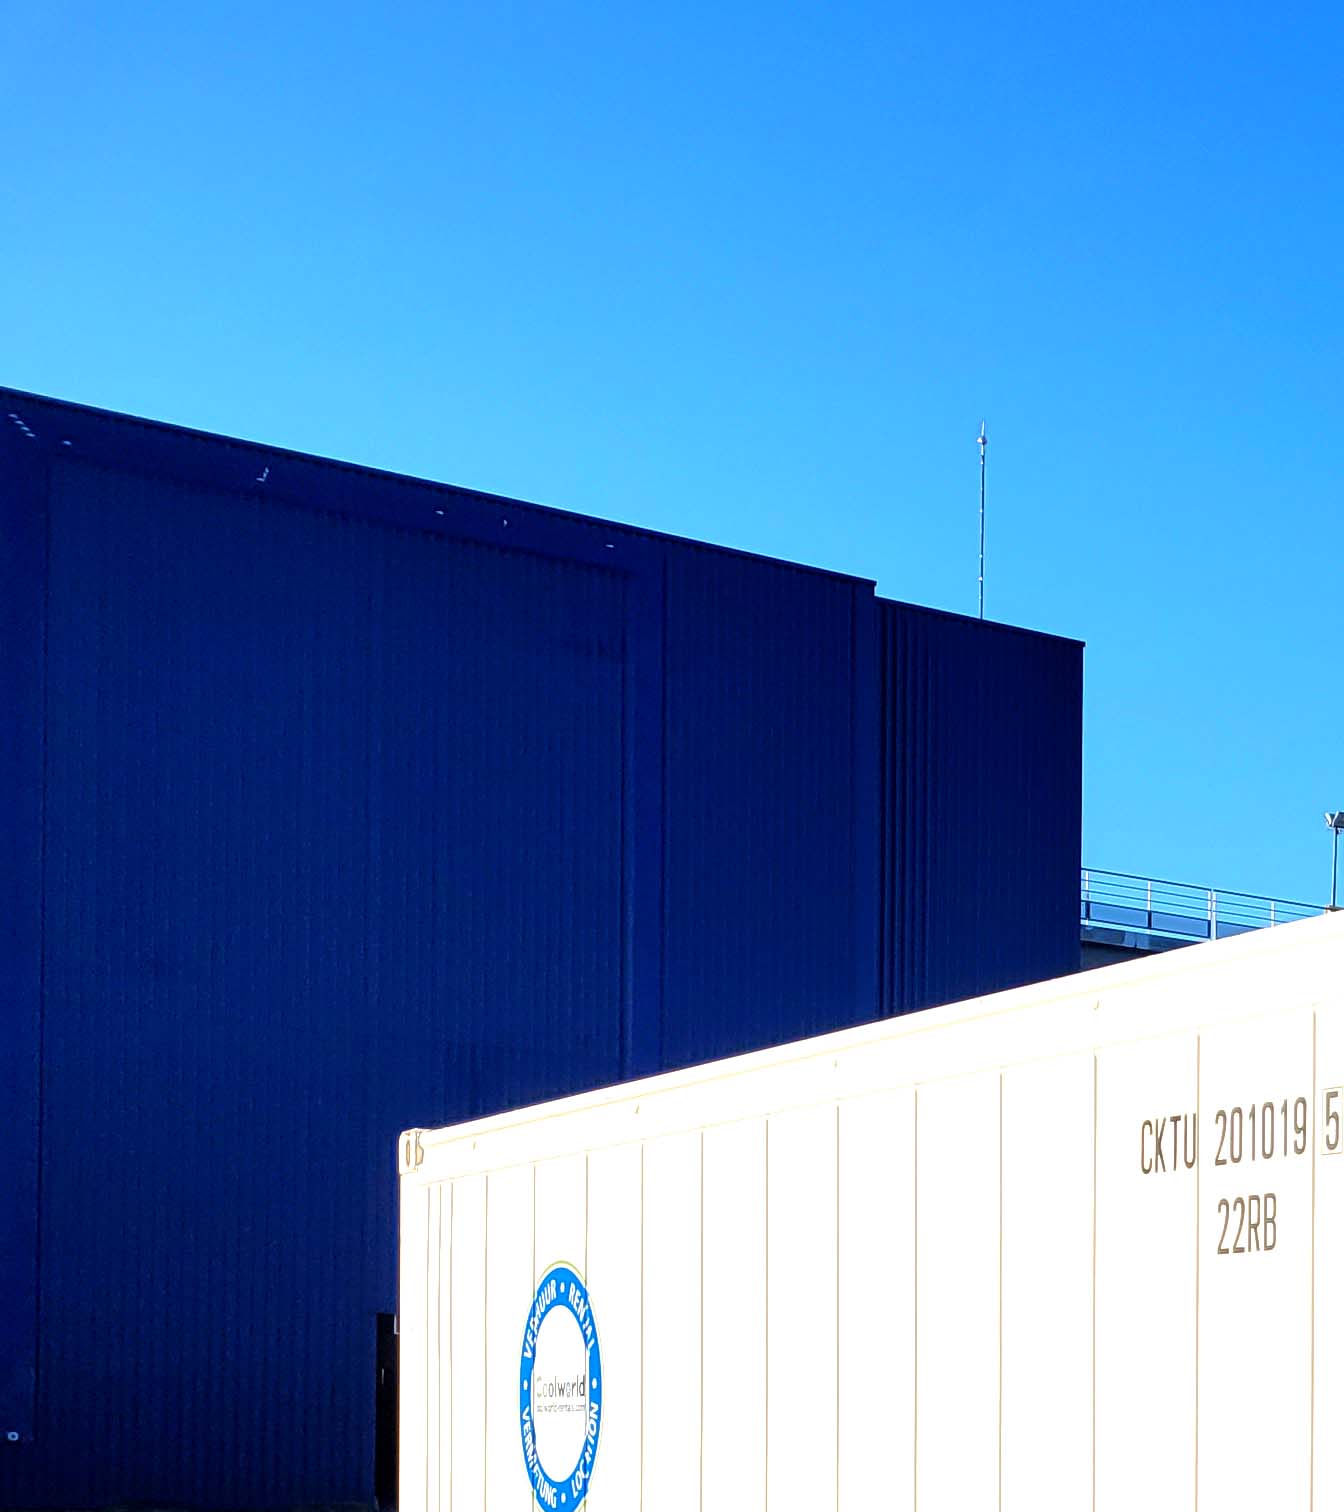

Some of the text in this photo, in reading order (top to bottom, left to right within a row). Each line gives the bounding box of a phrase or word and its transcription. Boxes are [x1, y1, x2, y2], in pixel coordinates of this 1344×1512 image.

[1141, 1089, 1341, 1174] CKTU 201019 5
[1217, 1193, 1277, 1255] 22RB
